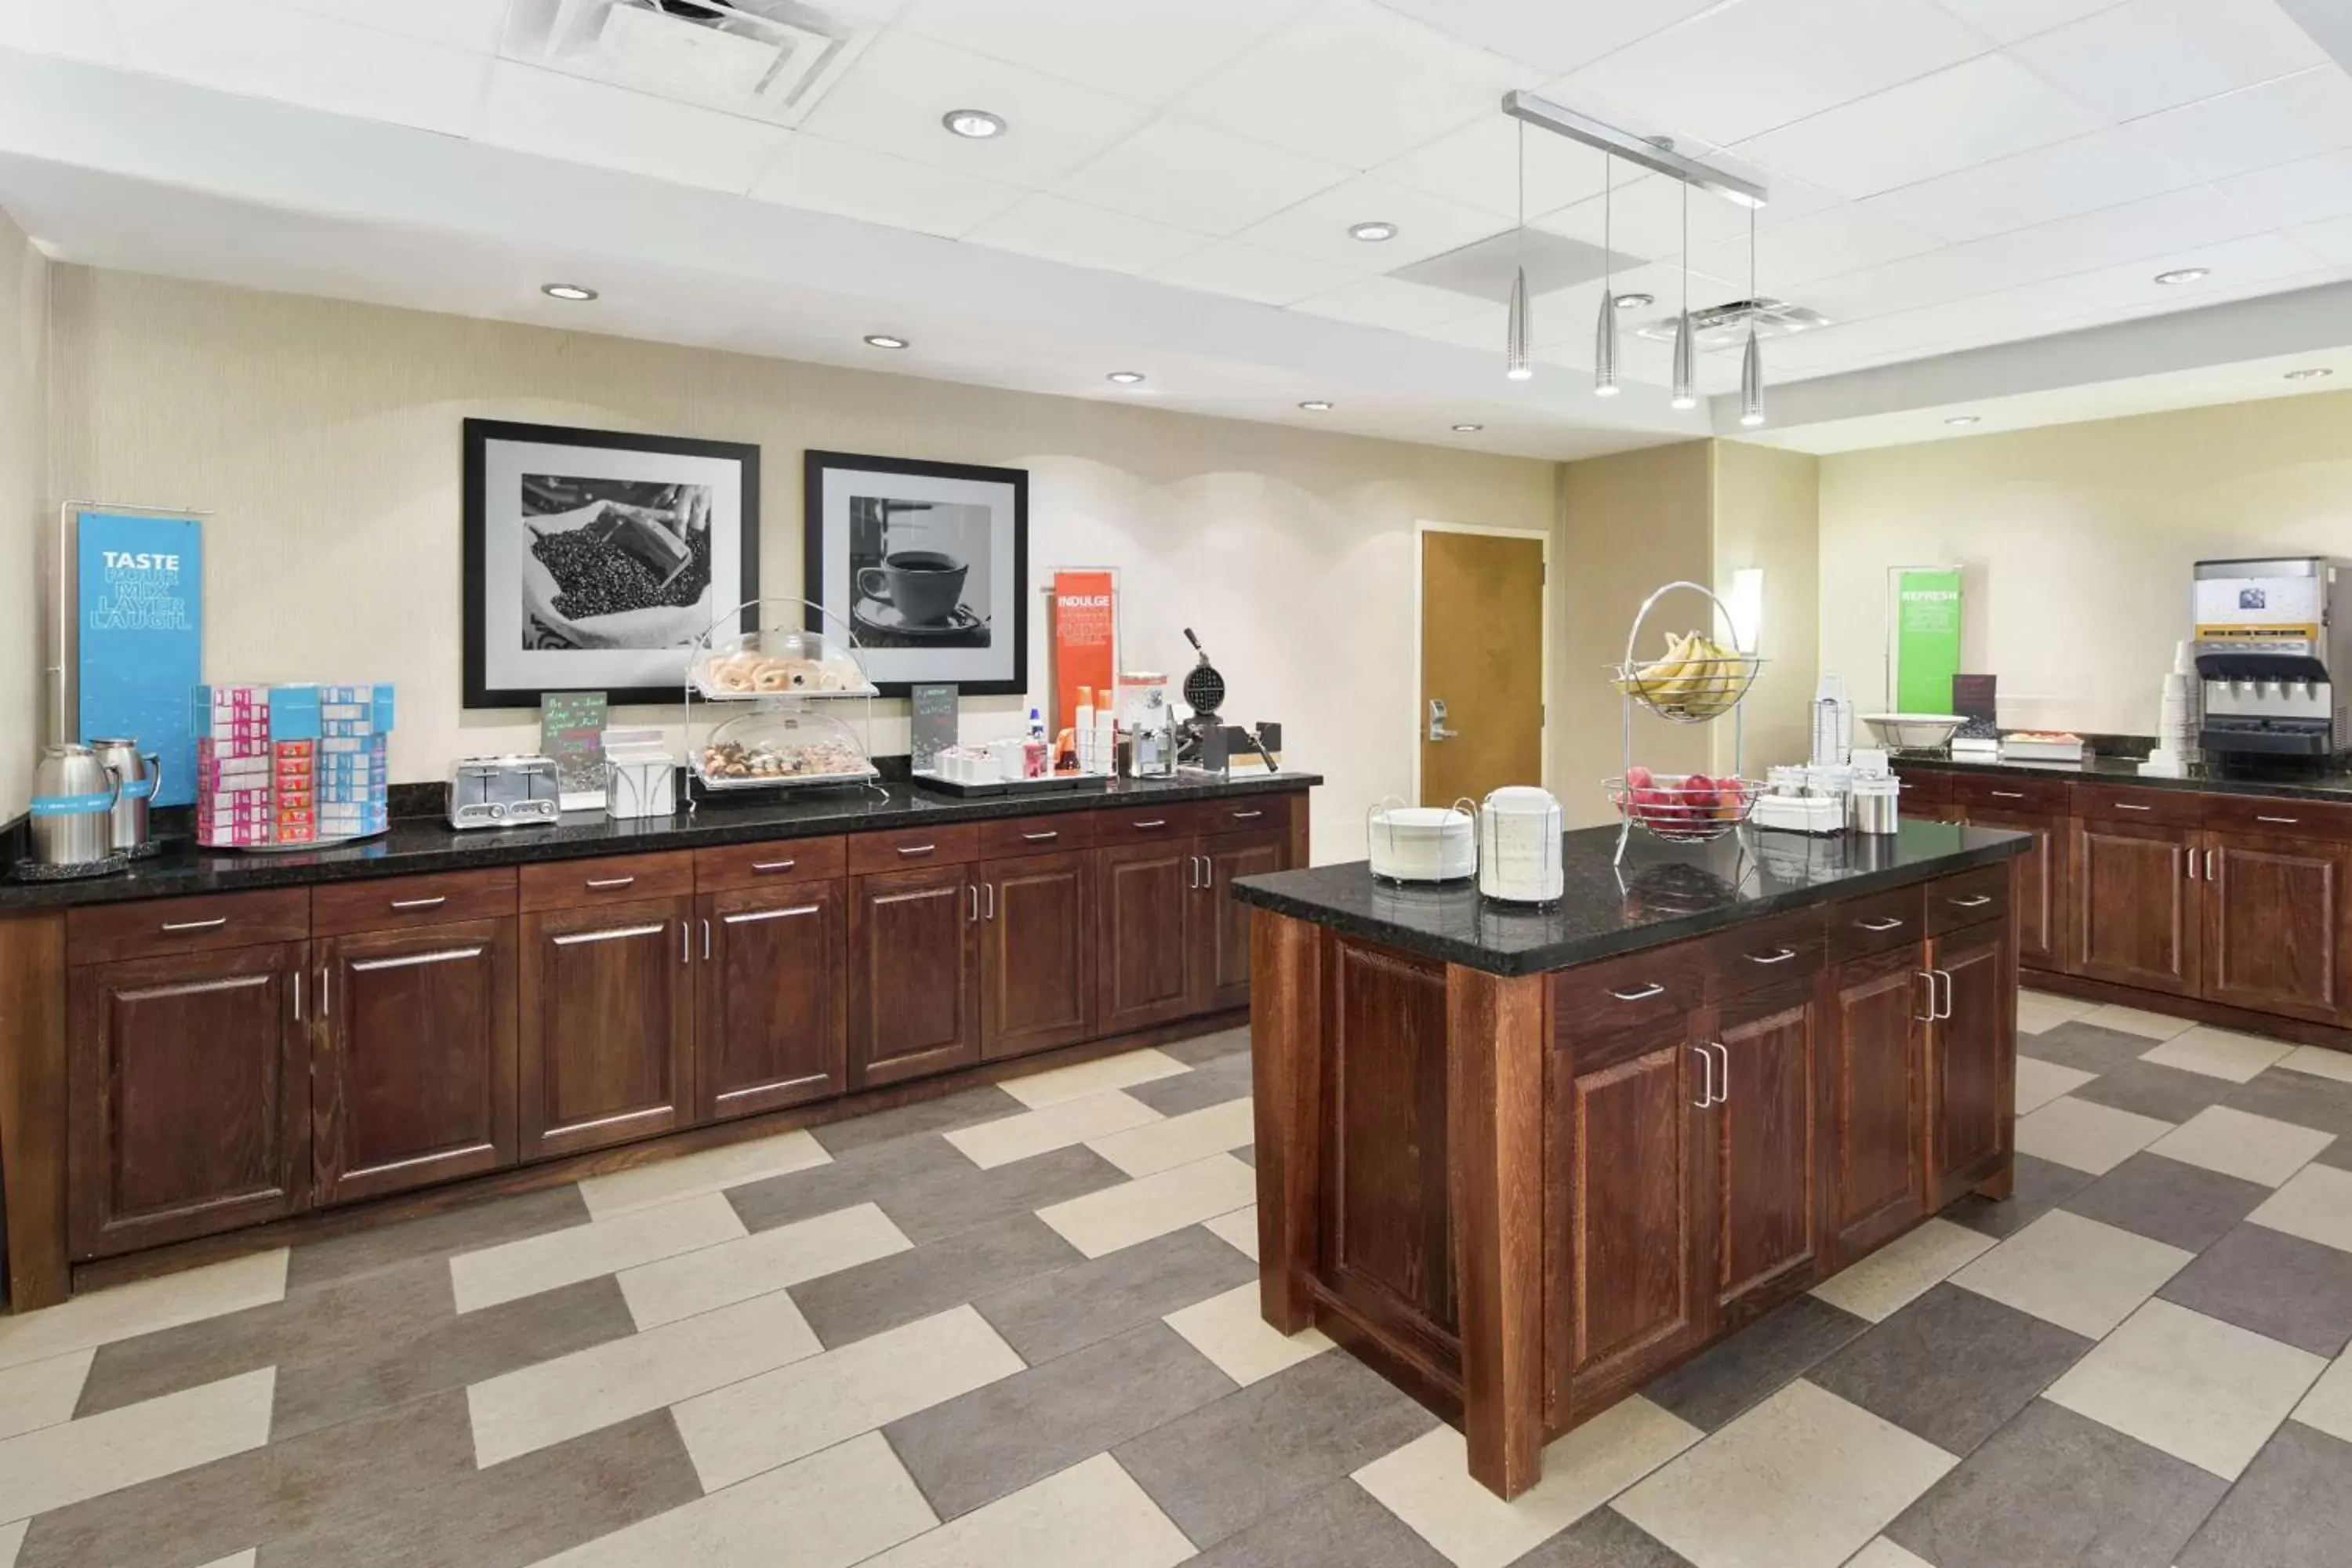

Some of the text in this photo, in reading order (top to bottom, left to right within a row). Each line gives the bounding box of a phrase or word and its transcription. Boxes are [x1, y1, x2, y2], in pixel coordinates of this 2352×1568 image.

[103, 551, 180, 571] TASTE
[105, 568, 179, 585] POUR
[115, 582, 170, 599] MIX
[1902, 590, 1958, 601] REFRESH
[99, 595, 185, 614] LAYER
[1058, 595, 1110, 607] INDULGE
